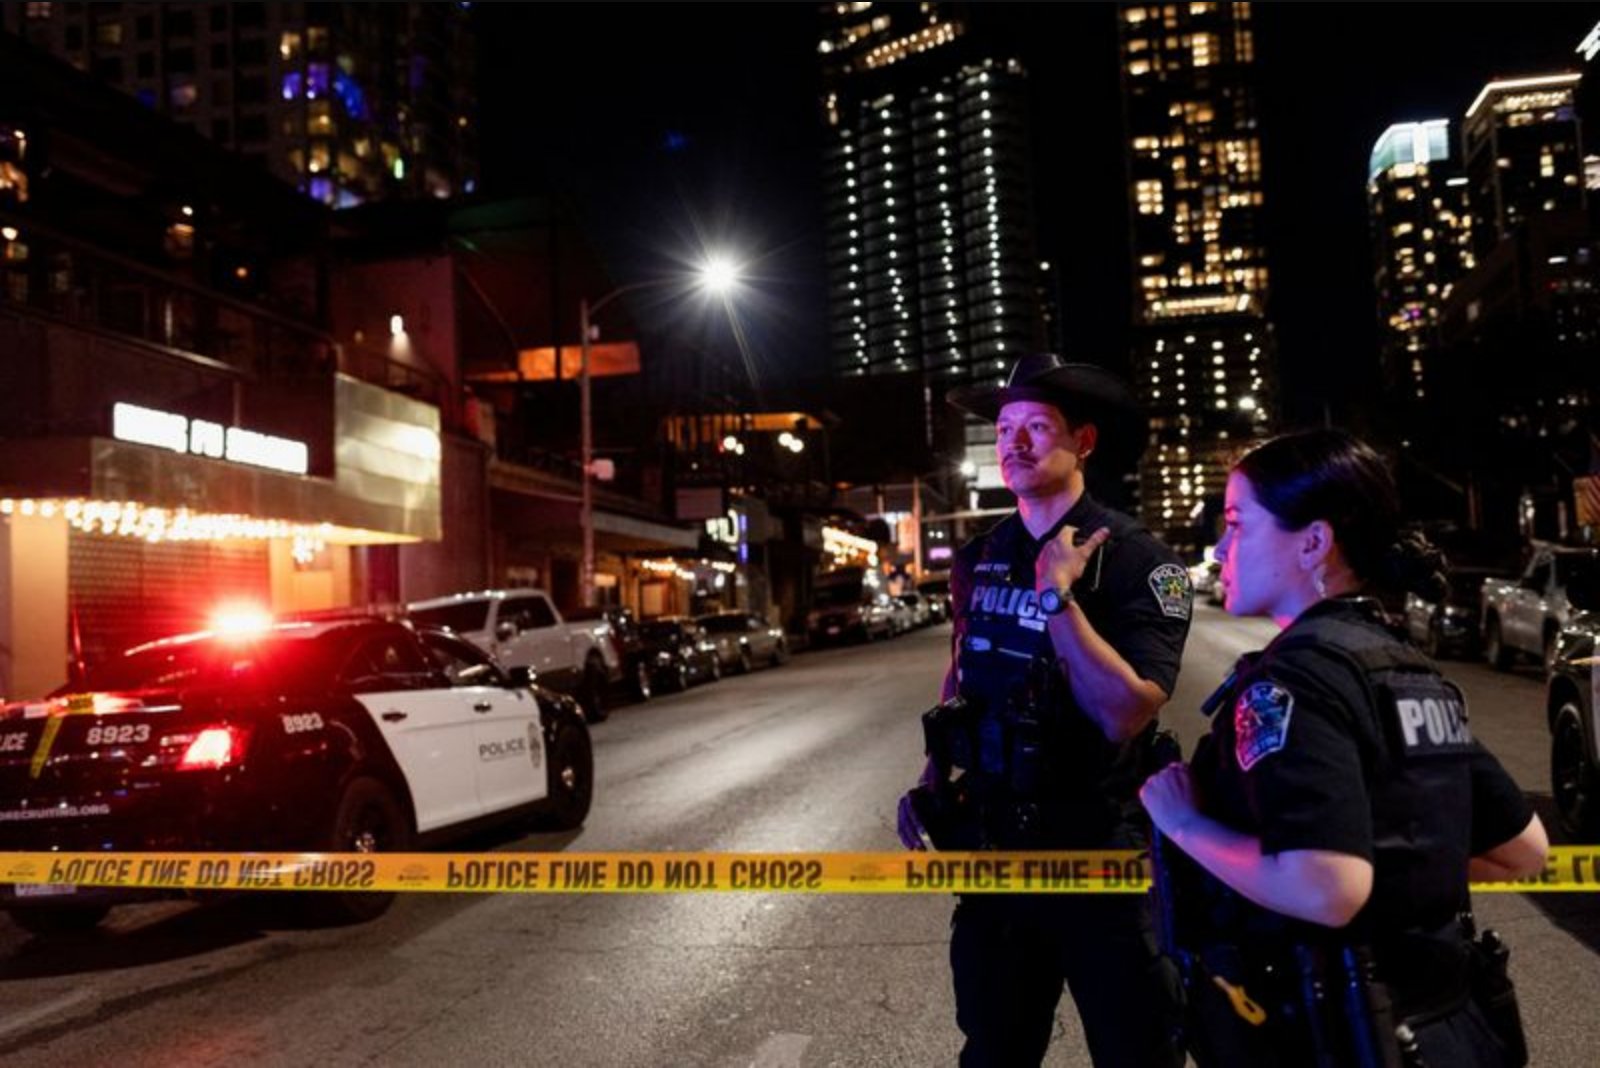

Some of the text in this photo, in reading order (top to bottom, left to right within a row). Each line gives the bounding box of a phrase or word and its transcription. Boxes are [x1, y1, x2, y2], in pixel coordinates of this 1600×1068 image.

[282, 712, 324, 733] 8923
[86, 724, 152, 745] 8923
[479, 738, 526, 756] POLICE
